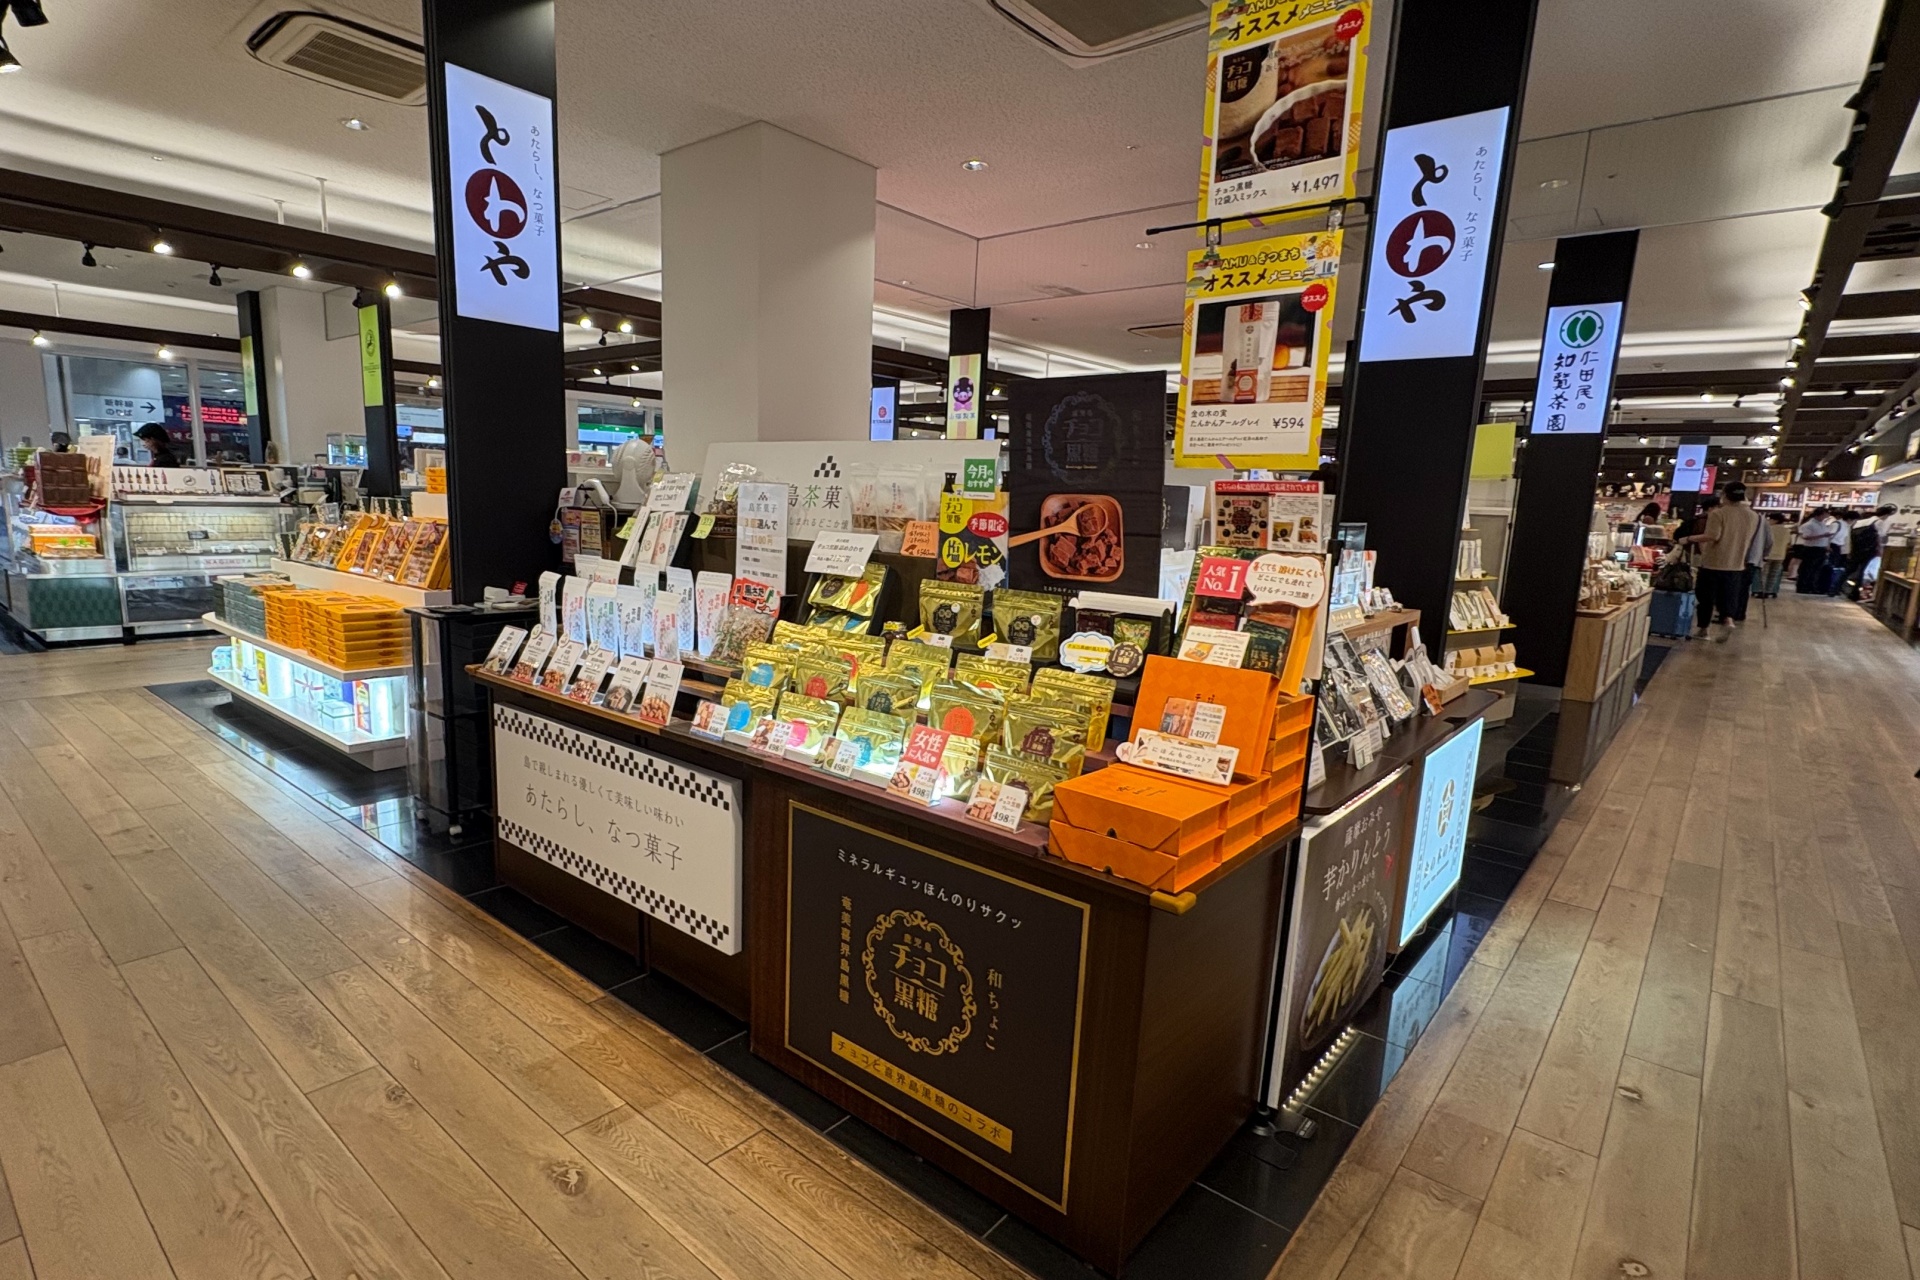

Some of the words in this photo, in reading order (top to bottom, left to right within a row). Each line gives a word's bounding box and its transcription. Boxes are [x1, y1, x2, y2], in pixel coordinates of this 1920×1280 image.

[1336, 18, 1363, 32] オススメ
[1214, 180, 1253, 196] チョコ黒糖
[1214, 188, 1267, 206] 12袋入ミックス
[1302, 293, 1328, 303] オススメ
[1547, 352, 1577, 432] 知覧茶園
[1190, 408, 1228, 419] 金の木の実
[1190, 417, 1261, 429] たんかんアールグレイ
[1272, 416, 1305, 430] ¥594
[966, 463, 994, 480] 今月の
[970, 518, 1006, 533] 季節限定
[1204, 565, 1227, 577] 人気
[914, 730, 943, 753] 女性
[889, 942, 948, 989] チョコ
[893, 976, 939, 1023] 黒糖
[984, 967, 1003, 1051] 和ちょこ
